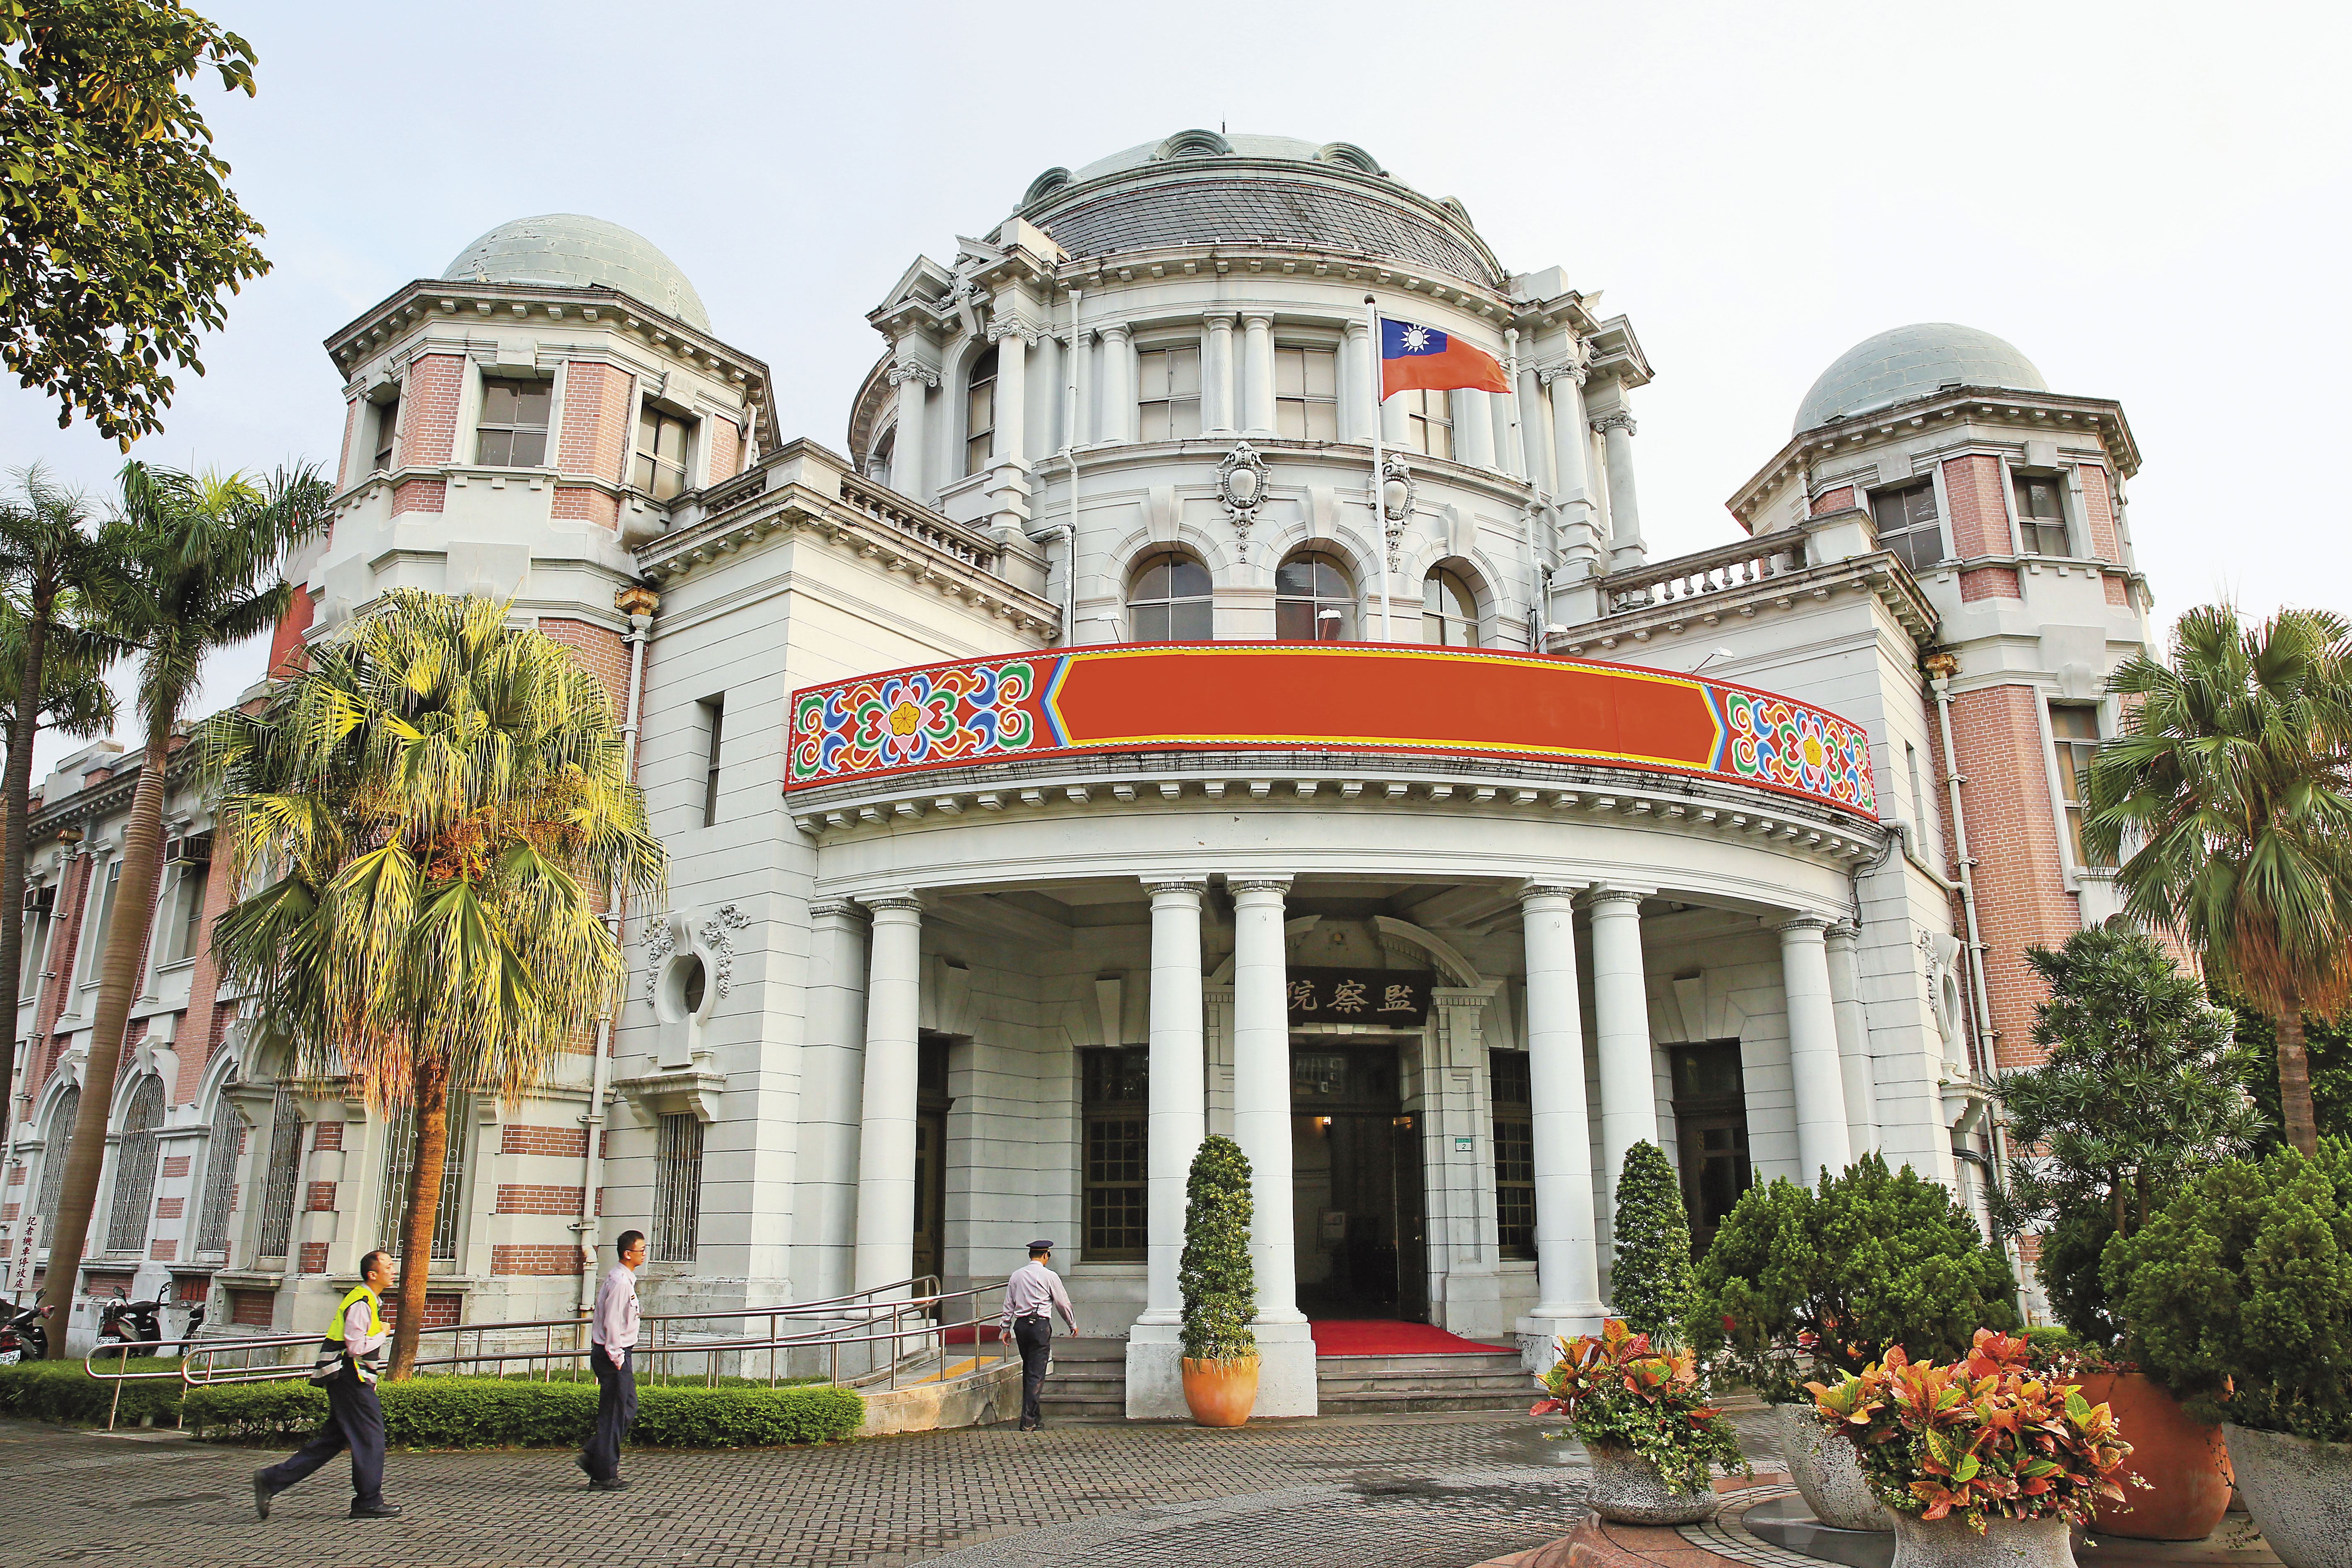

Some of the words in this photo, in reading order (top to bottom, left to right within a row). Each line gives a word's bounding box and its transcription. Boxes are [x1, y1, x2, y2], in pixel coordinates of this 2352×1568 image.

[13, 1216, 37, 1288] 記者機車停放處
